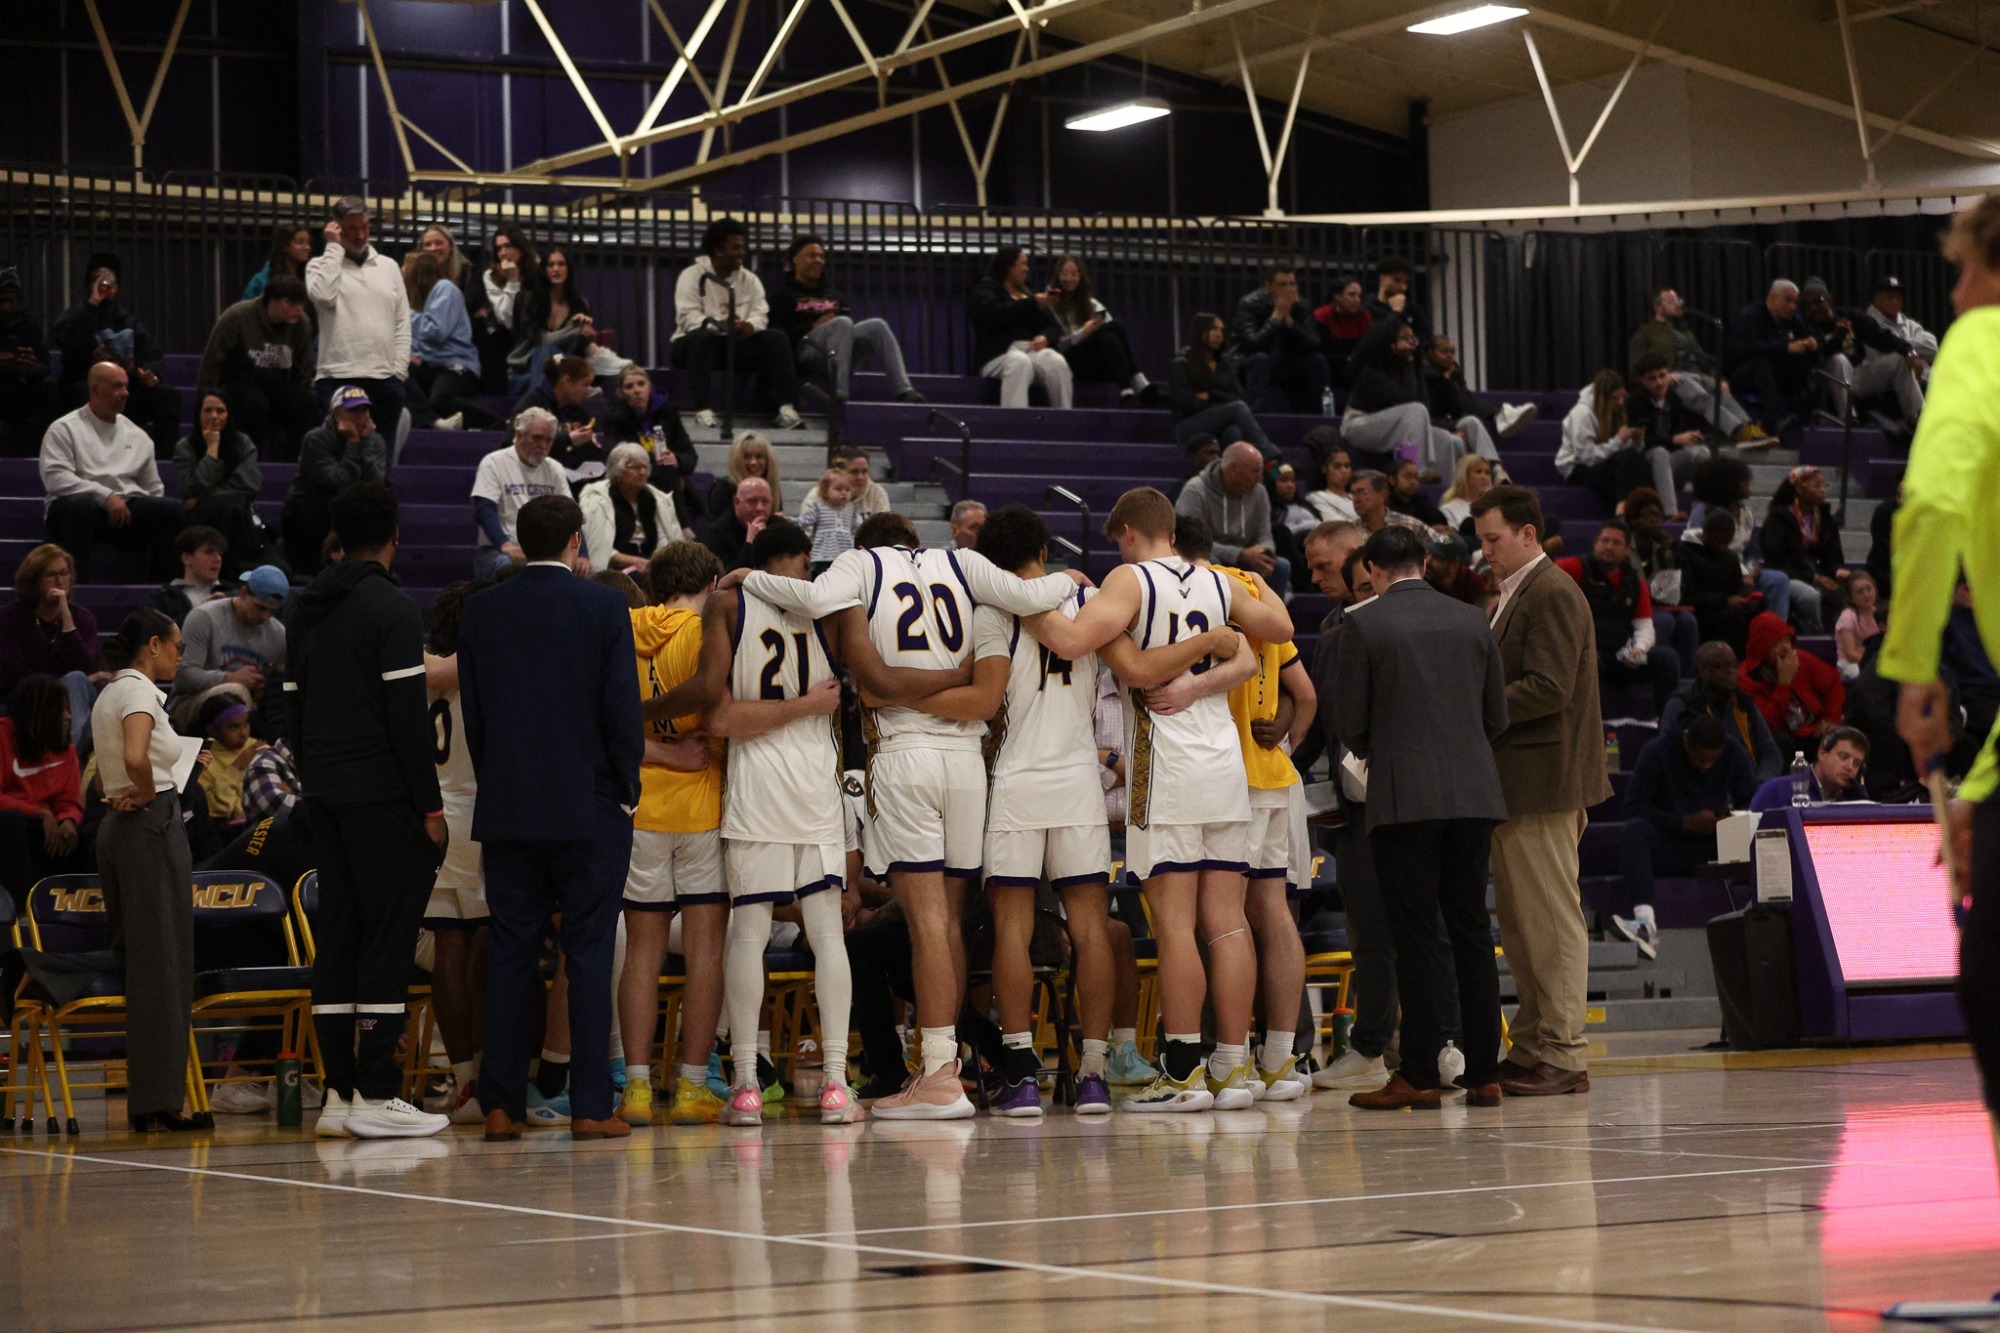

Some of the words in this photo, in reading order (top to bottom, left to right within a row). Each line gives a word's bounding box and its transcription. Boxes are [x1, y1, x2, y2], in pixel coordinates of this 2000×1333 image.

[892, 581, 964, 653] 20
[759, 626, 810, 702] 21
[49, 887, 107, 912] WC
[284, 1069, 299, 1087] G
